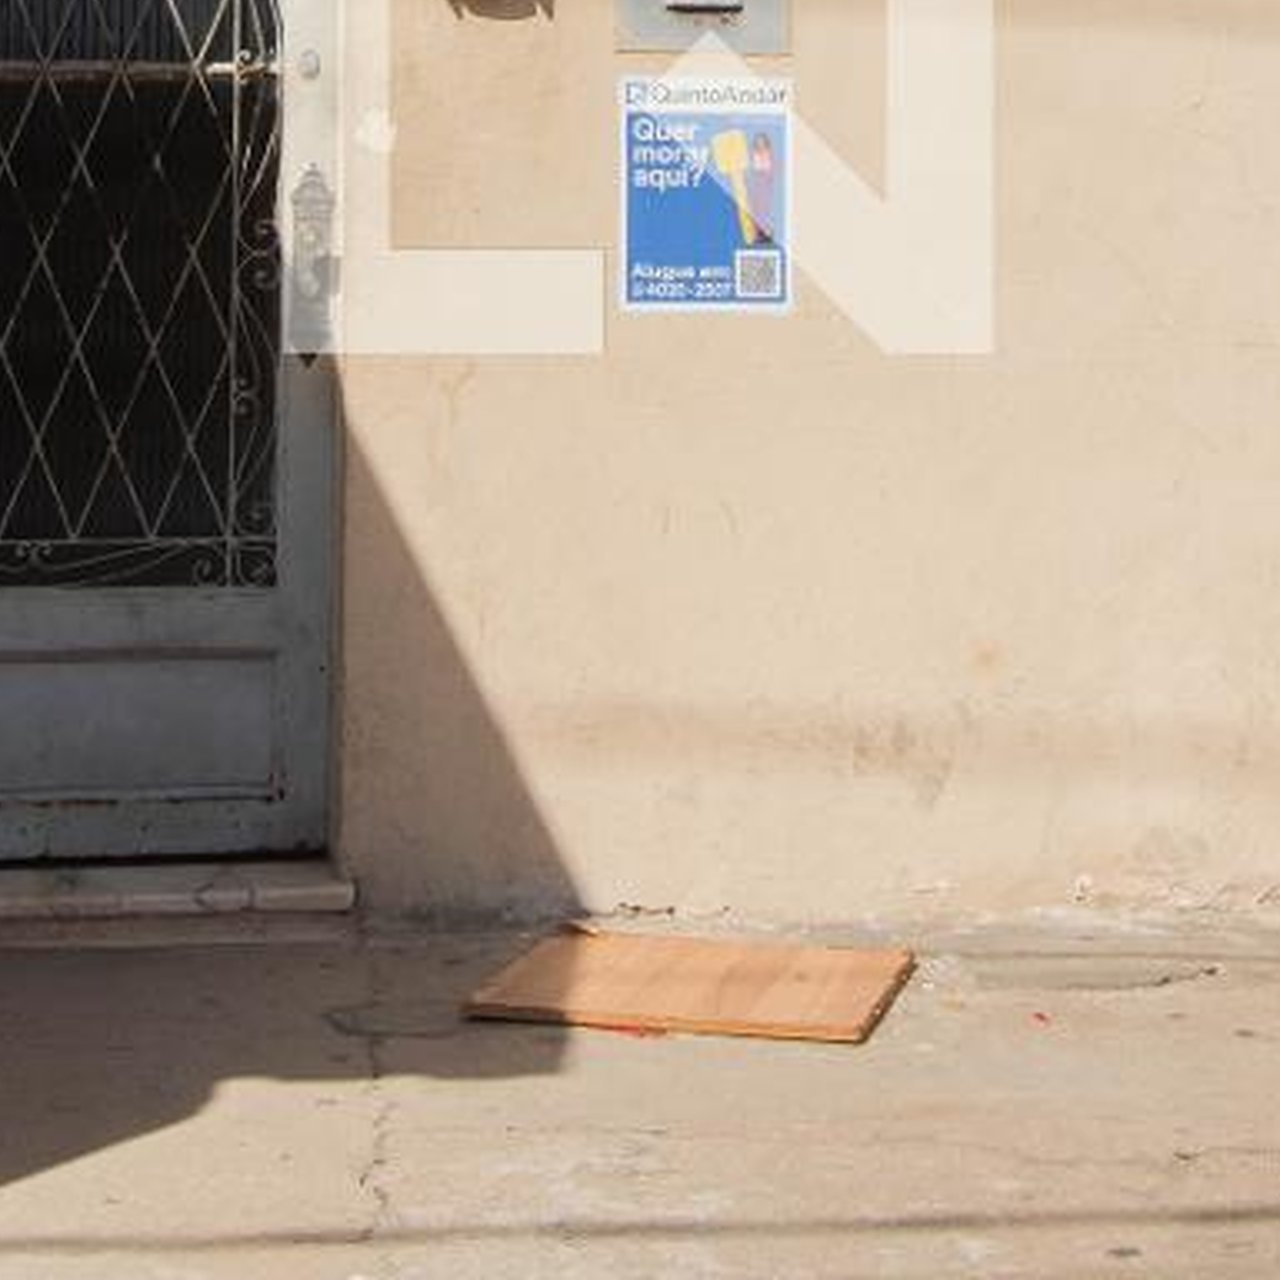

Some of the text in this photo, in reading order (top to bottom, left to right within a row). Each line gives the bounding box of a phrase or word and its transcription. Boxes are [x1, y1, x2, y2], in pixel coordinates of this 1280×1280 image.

[651, 82, 787, 105] QuintoAndar
[634, 117, 698, 142] Quer
[634, 164, 703, 193] aqui?
